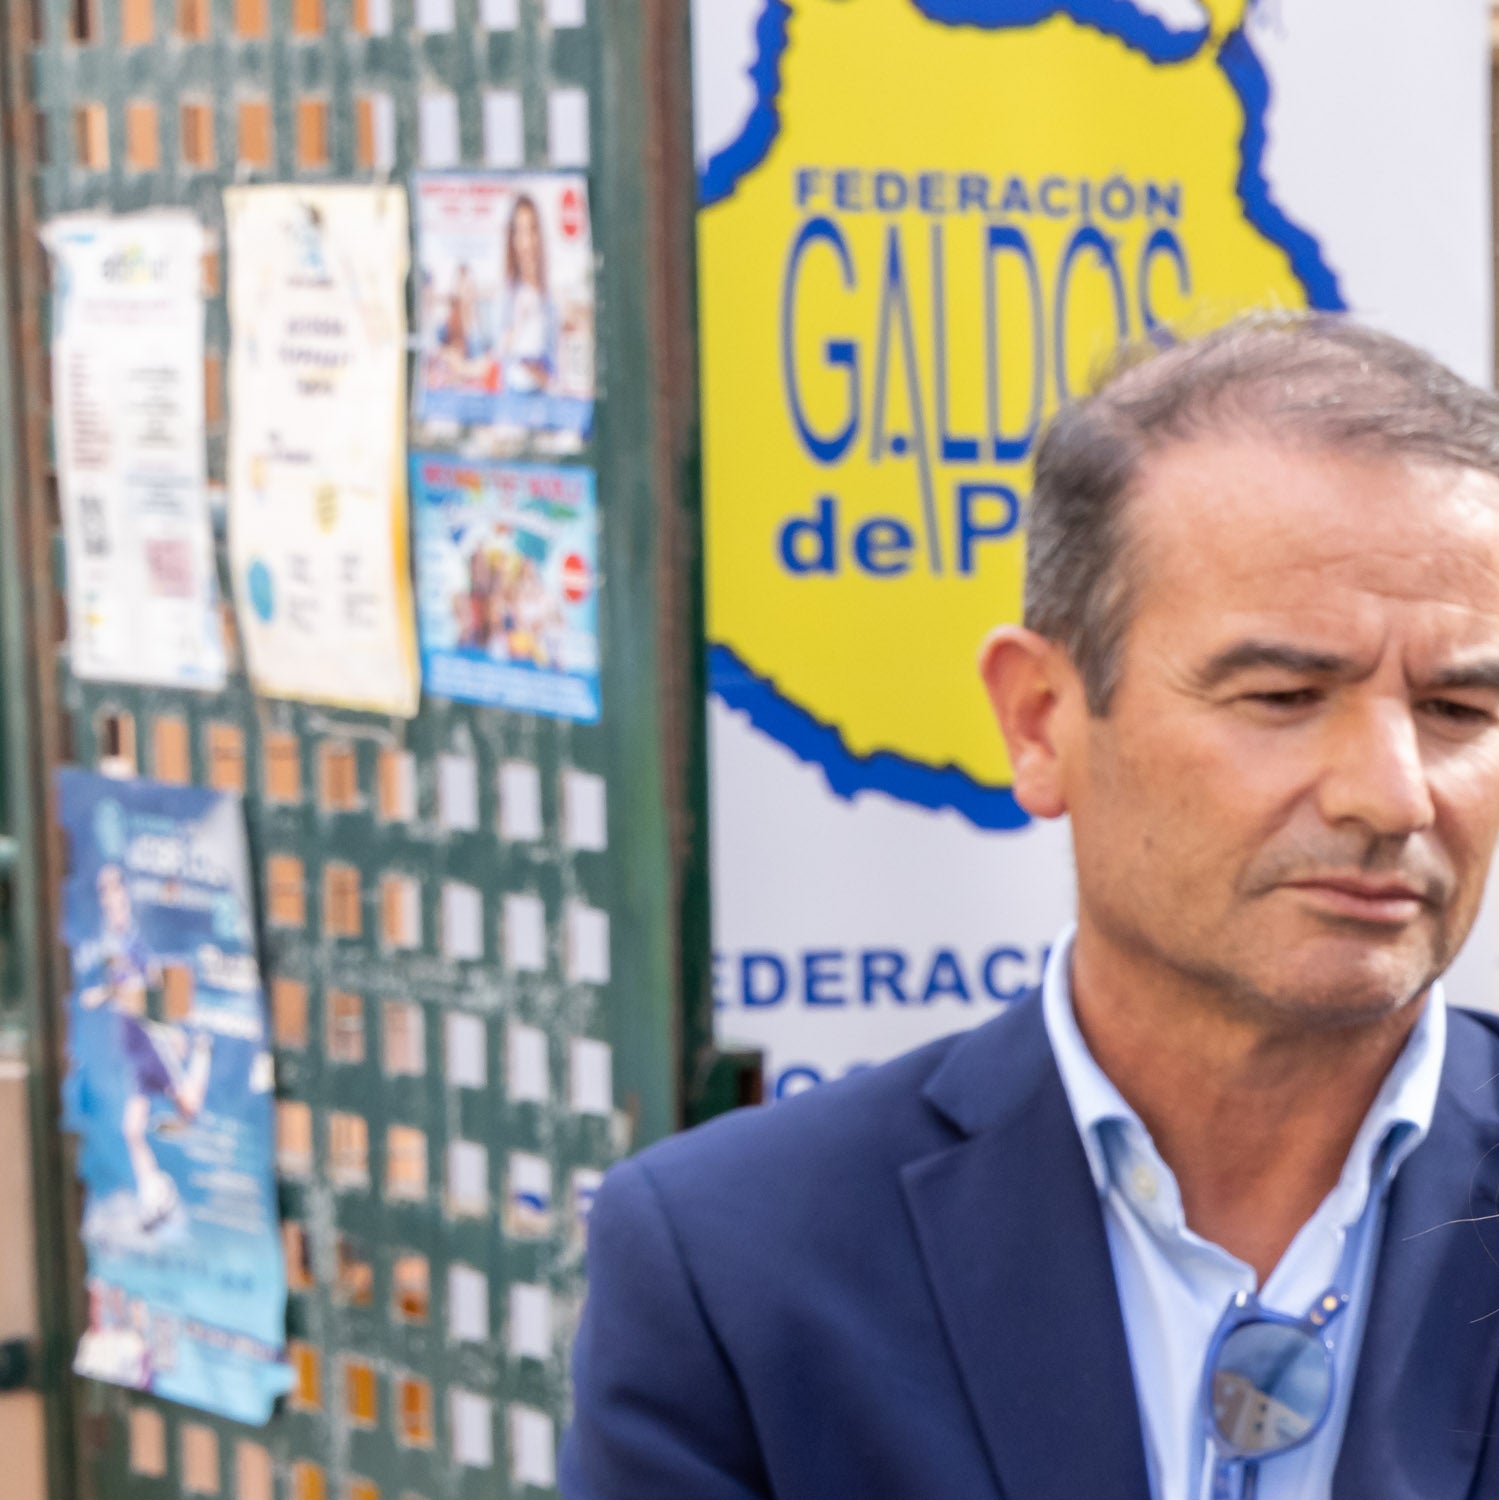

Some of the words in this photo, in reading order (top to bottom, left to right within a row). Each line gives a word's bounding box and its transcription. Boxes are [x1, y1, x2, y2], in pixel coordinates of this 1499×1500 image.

[793, 169, 1182, 222] FEDERACIÓN
[776, 494, 915, 577] de
[955, 484, 1024, 577] P
[712, 947, 1052, 1008] DERAC
